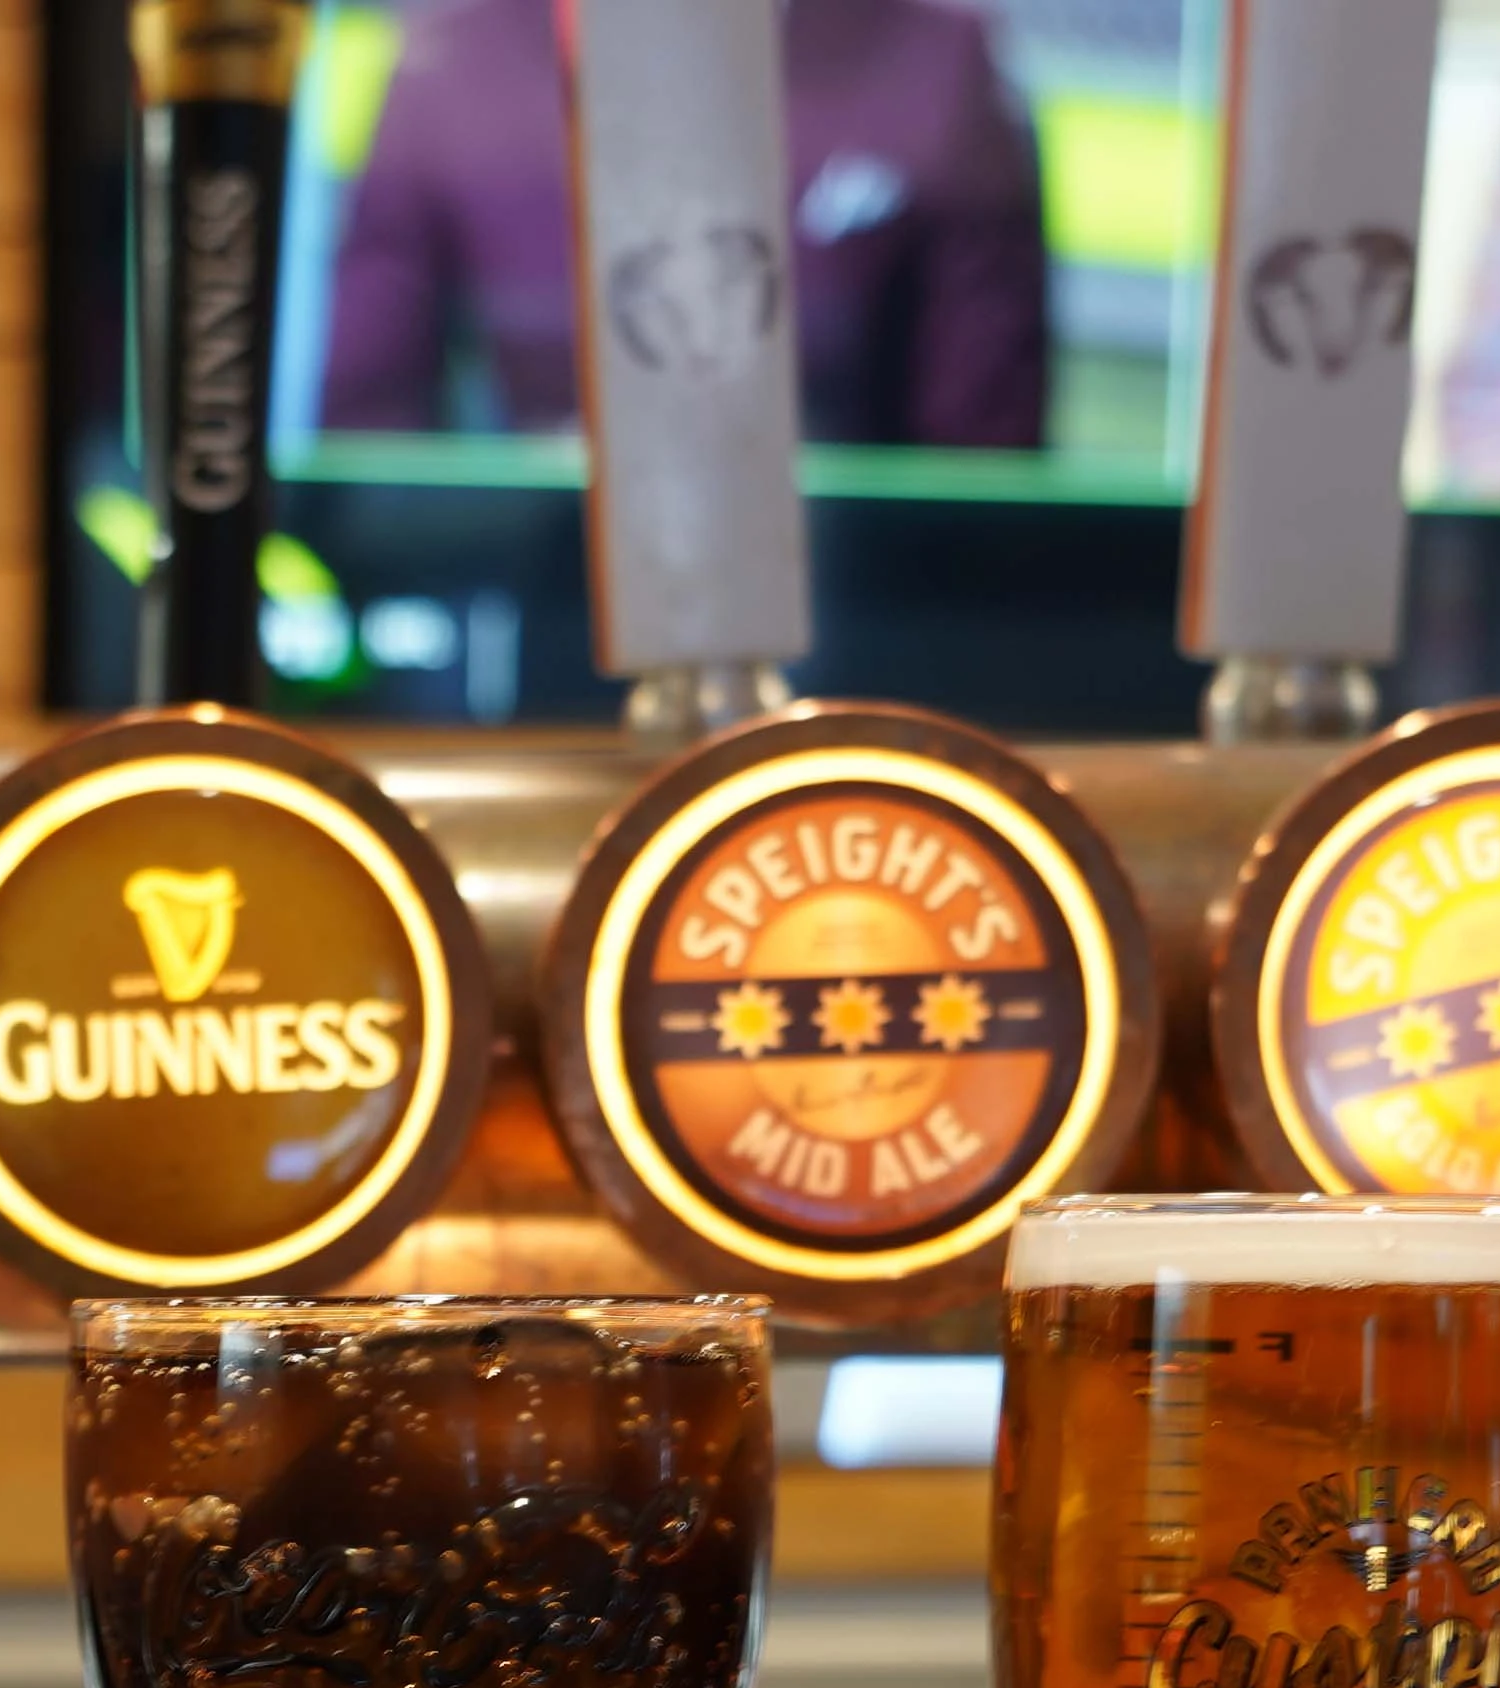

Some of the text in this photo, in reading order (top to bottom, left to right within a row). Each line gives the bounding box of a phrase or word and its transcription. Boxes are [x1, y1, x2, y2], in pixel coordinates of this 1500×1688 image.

[172, 168, 260, 512] GUINNESS
[678, 813, 1021, 968] SPEIGHT'S
[727, 1102, 986, 1198] MID ALE
